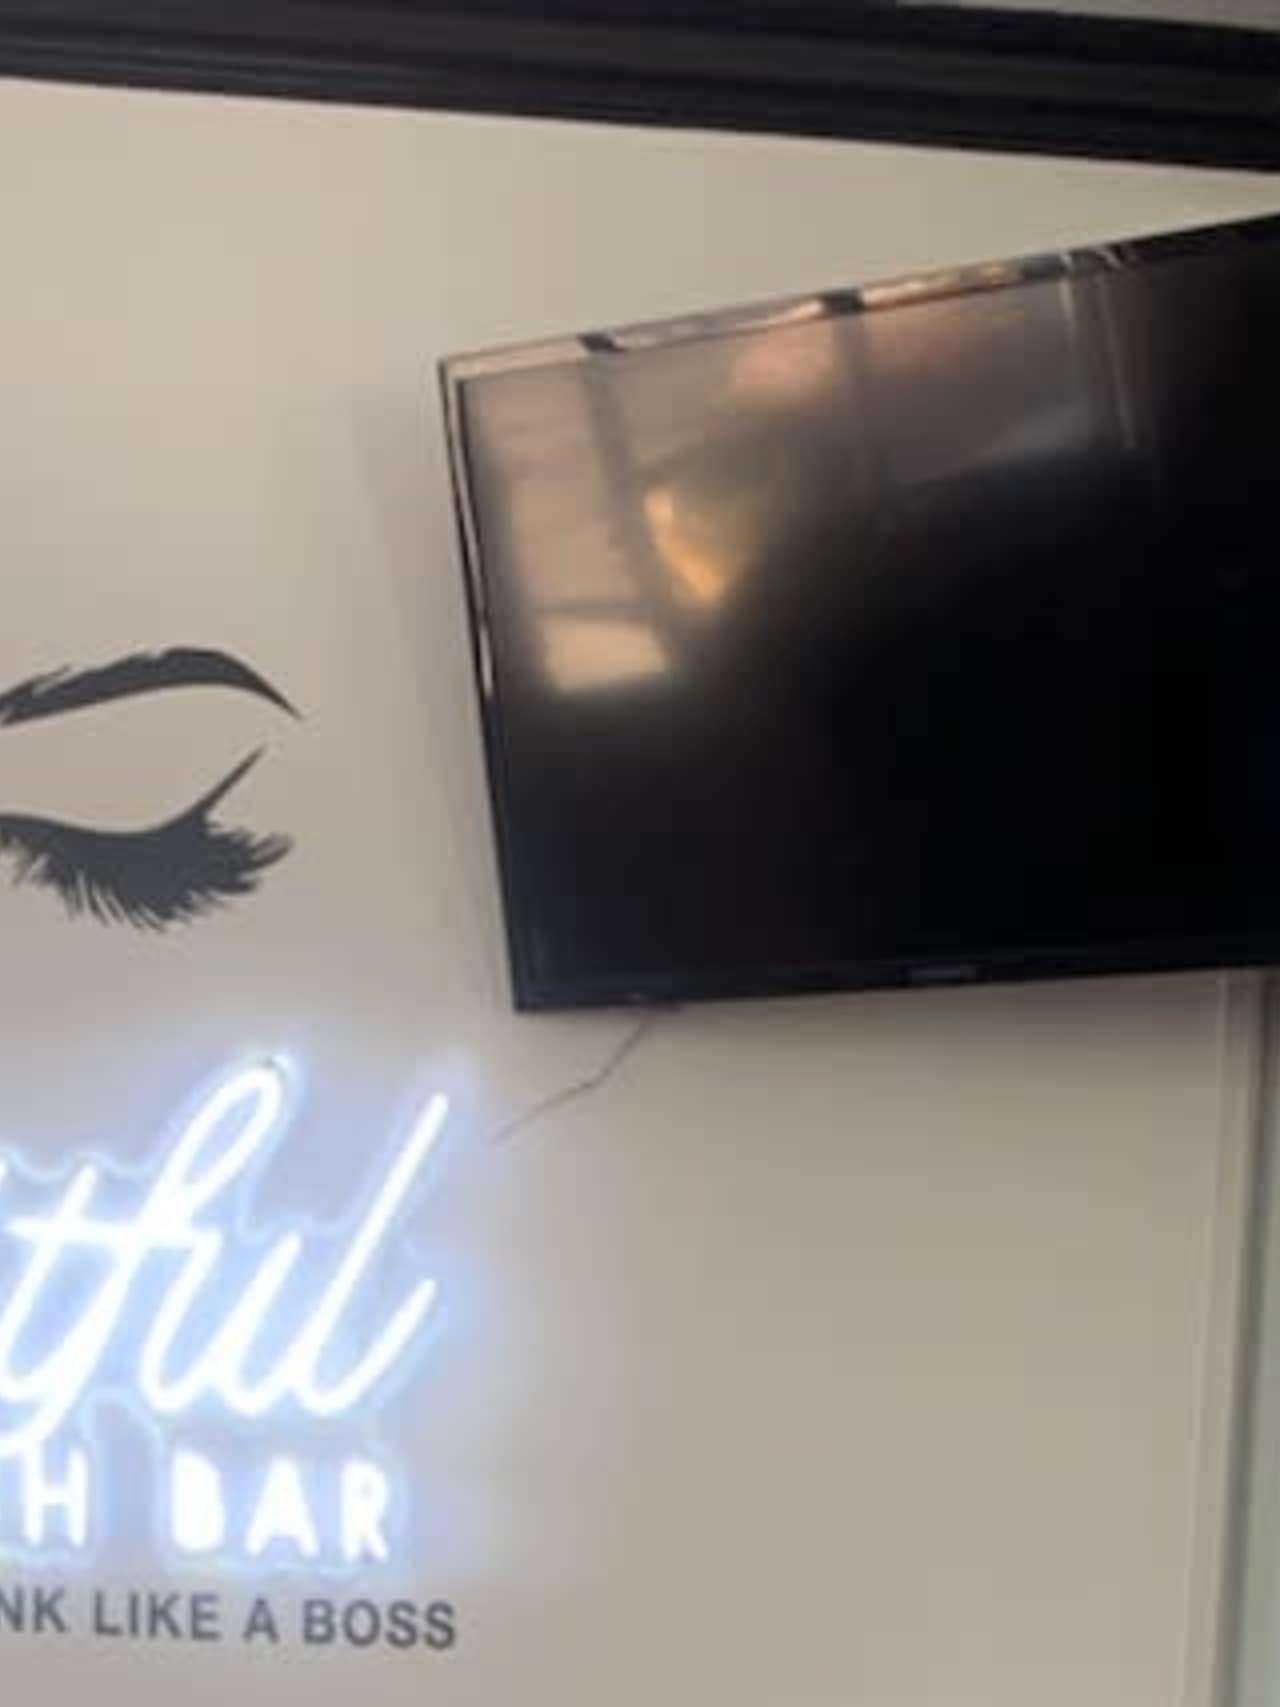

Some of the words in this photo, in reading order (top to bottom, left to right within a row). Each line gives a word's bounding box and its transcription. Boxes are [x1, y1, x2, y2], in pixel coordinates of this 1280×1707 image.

[170, 1447, 390, 1562] BAR
[93, 1593, 223, 1641] LIKE
[243, 1597, 280, 1643] A
[303, 1599, 458, 1650] BOSS
